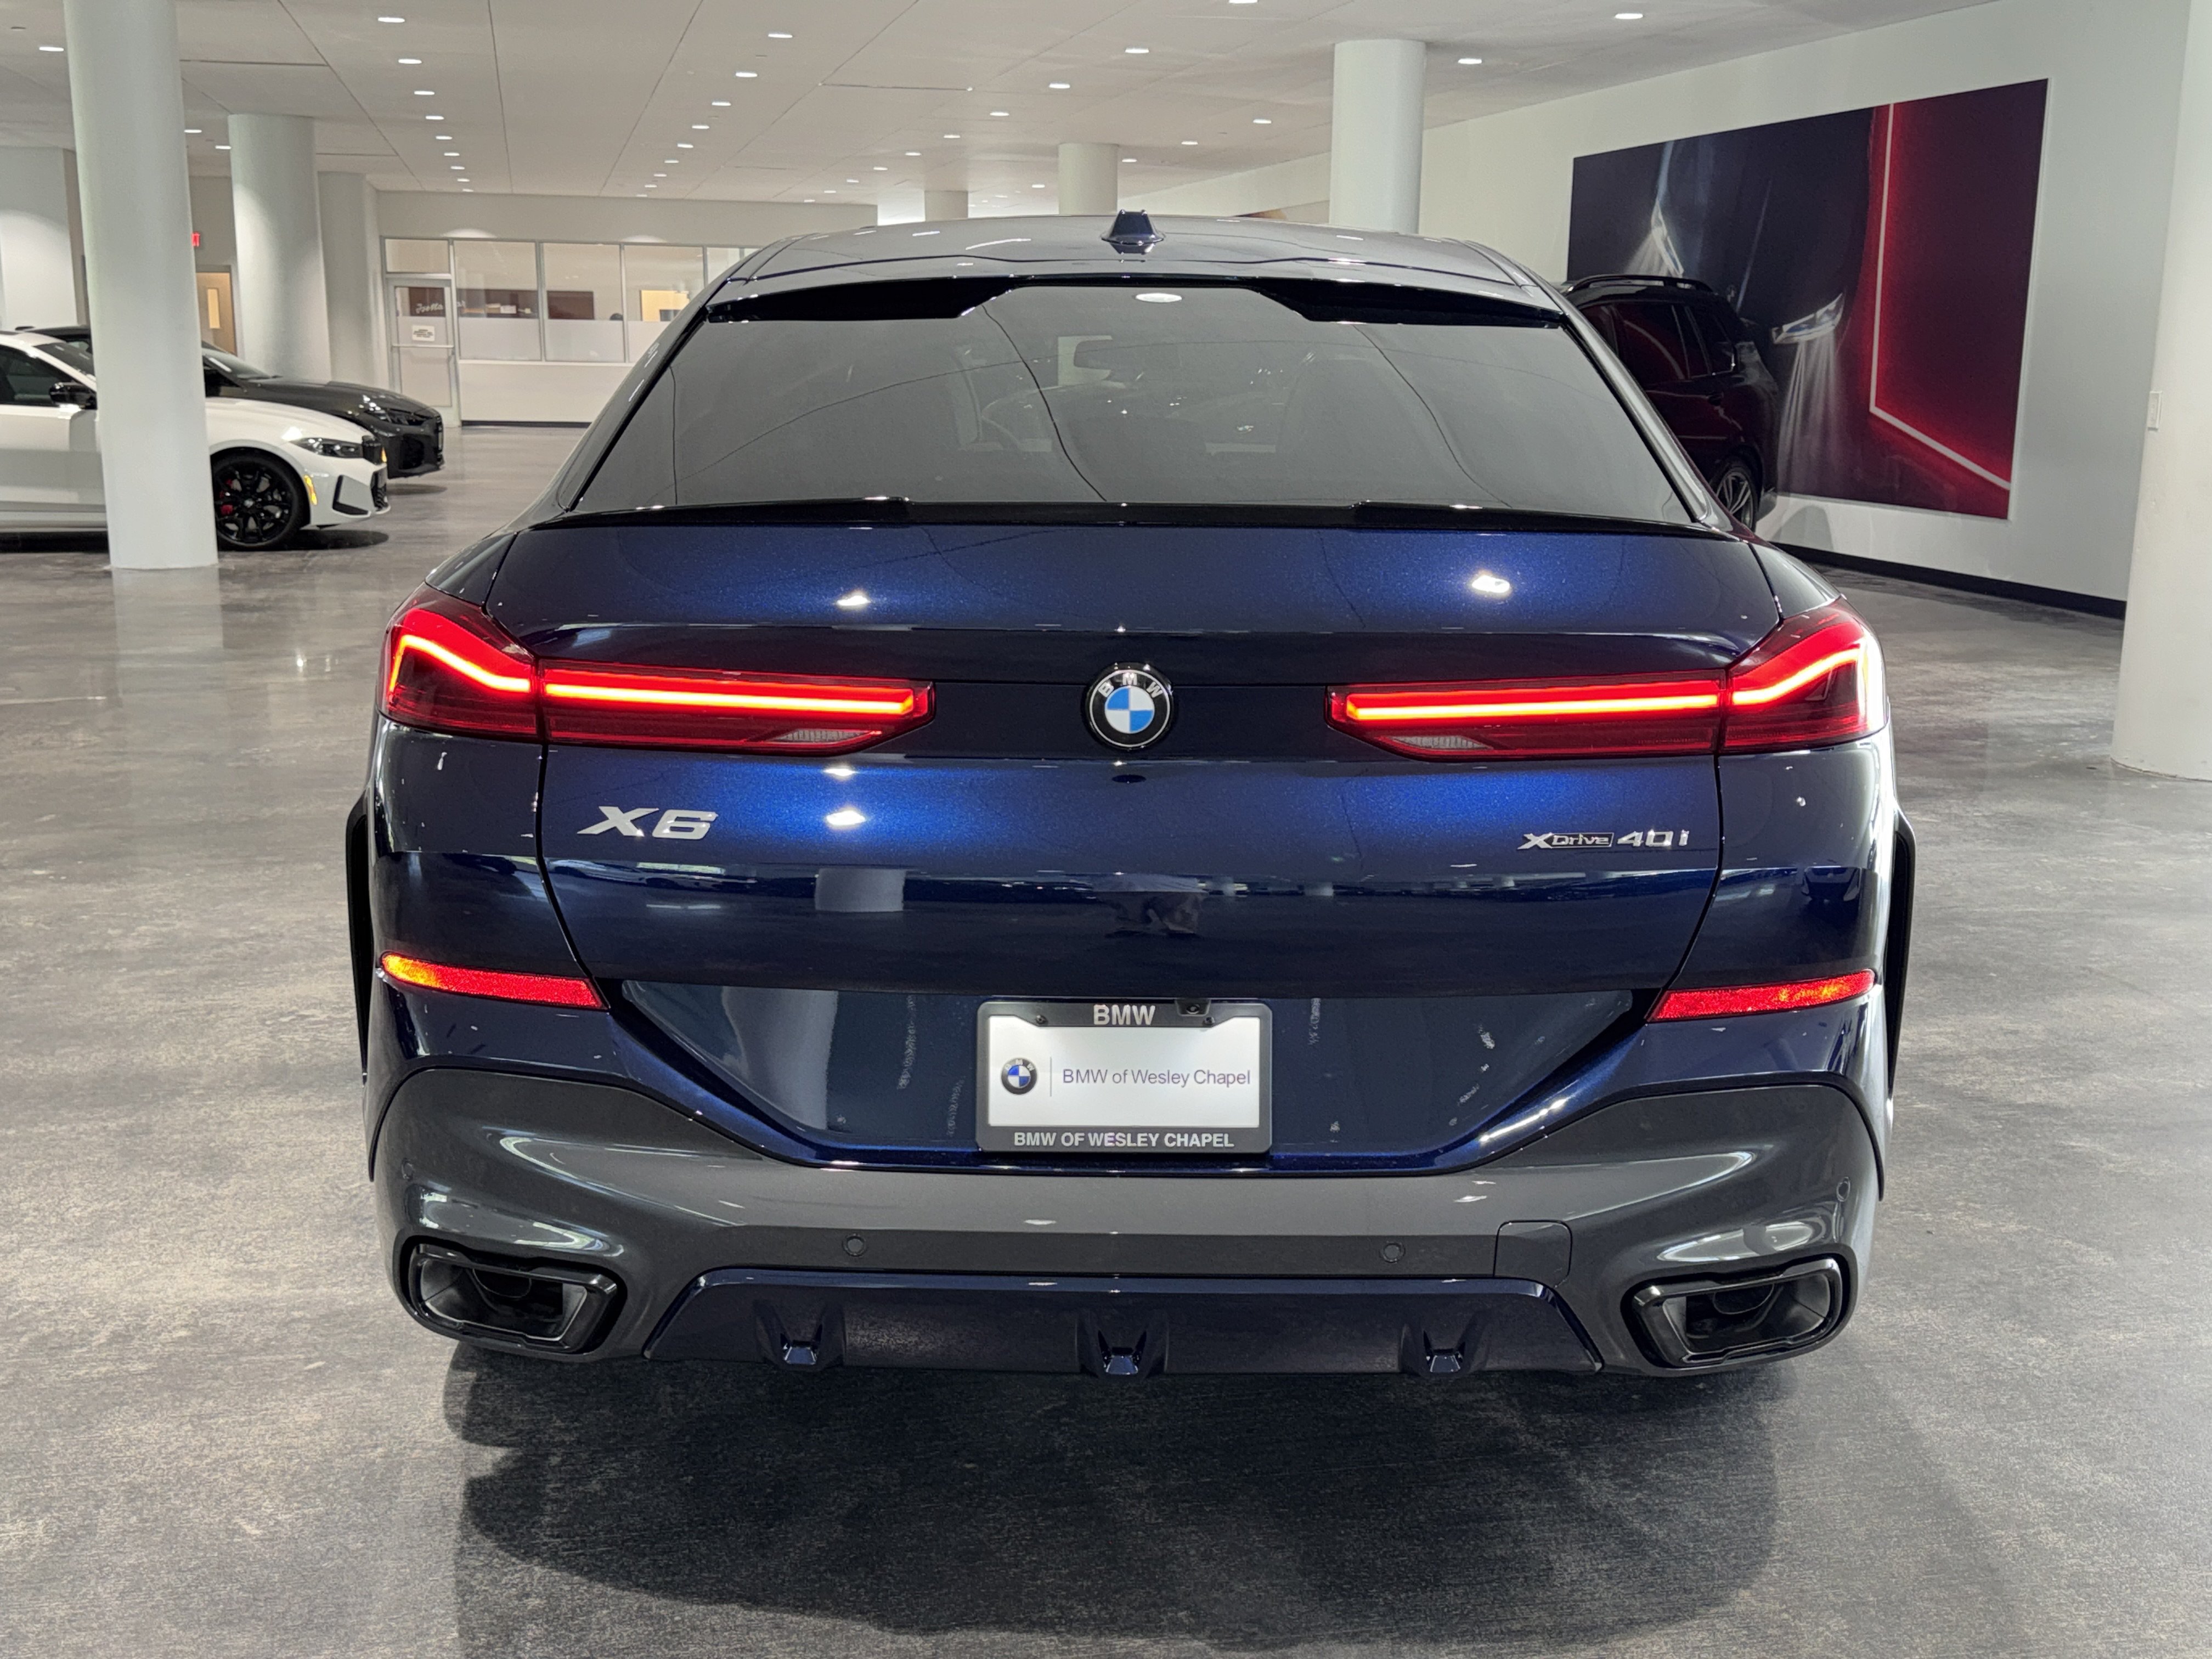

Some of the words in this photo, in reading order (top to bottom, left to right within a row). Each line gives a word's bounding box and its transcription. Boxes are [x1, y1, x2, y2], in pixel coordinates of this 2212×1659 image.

[1098, 673, 1164, 698] BMW
[577, 805, 719, 840] X6
[1093, 1004, 1156, 1025] BMW
[1063, 1069, 1108, 1084] BMW
[1112, 1069, 1128, 1084] of
[1131, 1069, 1190, 1088] Wesley
[1193, 1069, 1251, 1088] Chapel
[1014, 1132, 1057, 1146] BMW
[1060, 1132, 1085, 1147] OF
[1088, 1132, 1160, 1147] WESLEY
[1164, 1133, 1235, 1148] CHAPEL
